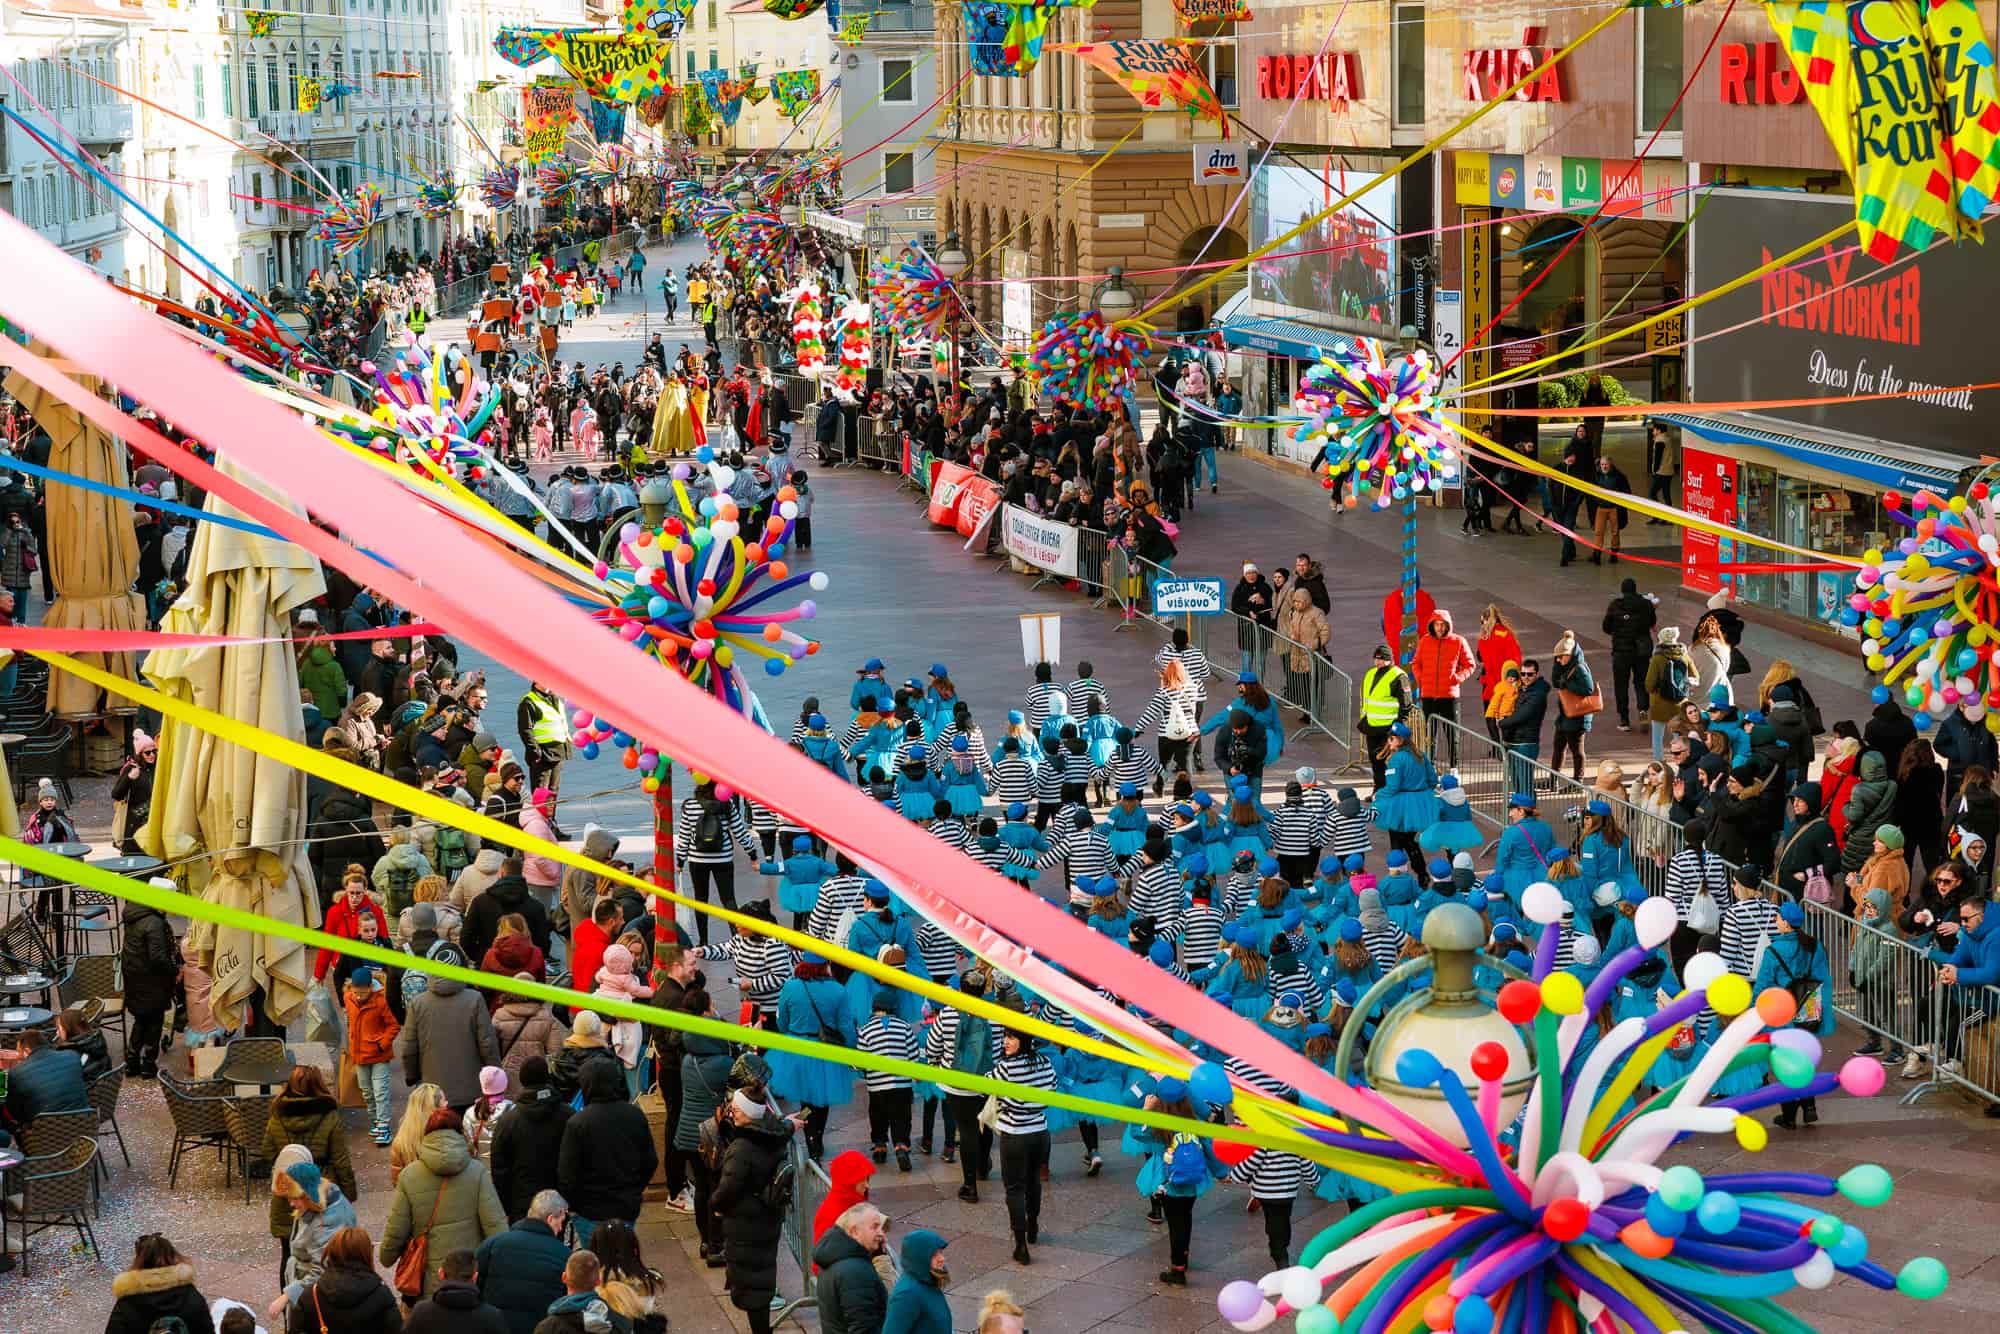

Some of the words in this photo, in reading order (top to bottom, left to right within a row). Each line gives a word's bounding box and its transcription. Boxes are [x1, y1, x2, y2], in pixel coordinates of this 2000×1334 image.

[1257, 54, 1358, 101] ROBNA
[1463, 27, 1571, 103] KUĆA
[1720, 42, 1803, 105] RIJ
[1209, 149, 1236, 168] dm
[1537, 160, 1553, 188] dm
[1575, 164, 1587, 192] D
[1605, 175, 1641, 201] MANA
[904, 207, 937, 220] TEZ
[1472, 218, 1482, 303] HAPPY
[1416, 273, 1426, 330] europlakat
[1443, 332, 1460, 347] 2.
[1472, 313, 1482, 381] HOME
[1807, 349, 1849, 386] Dress
[1848, 358, 1875, 398] for
[1878, 363, 1903, 395] the
[1687, 470, 1703, 489] Surf
[1167, 596, 1210, 609] VIŠKOVO
